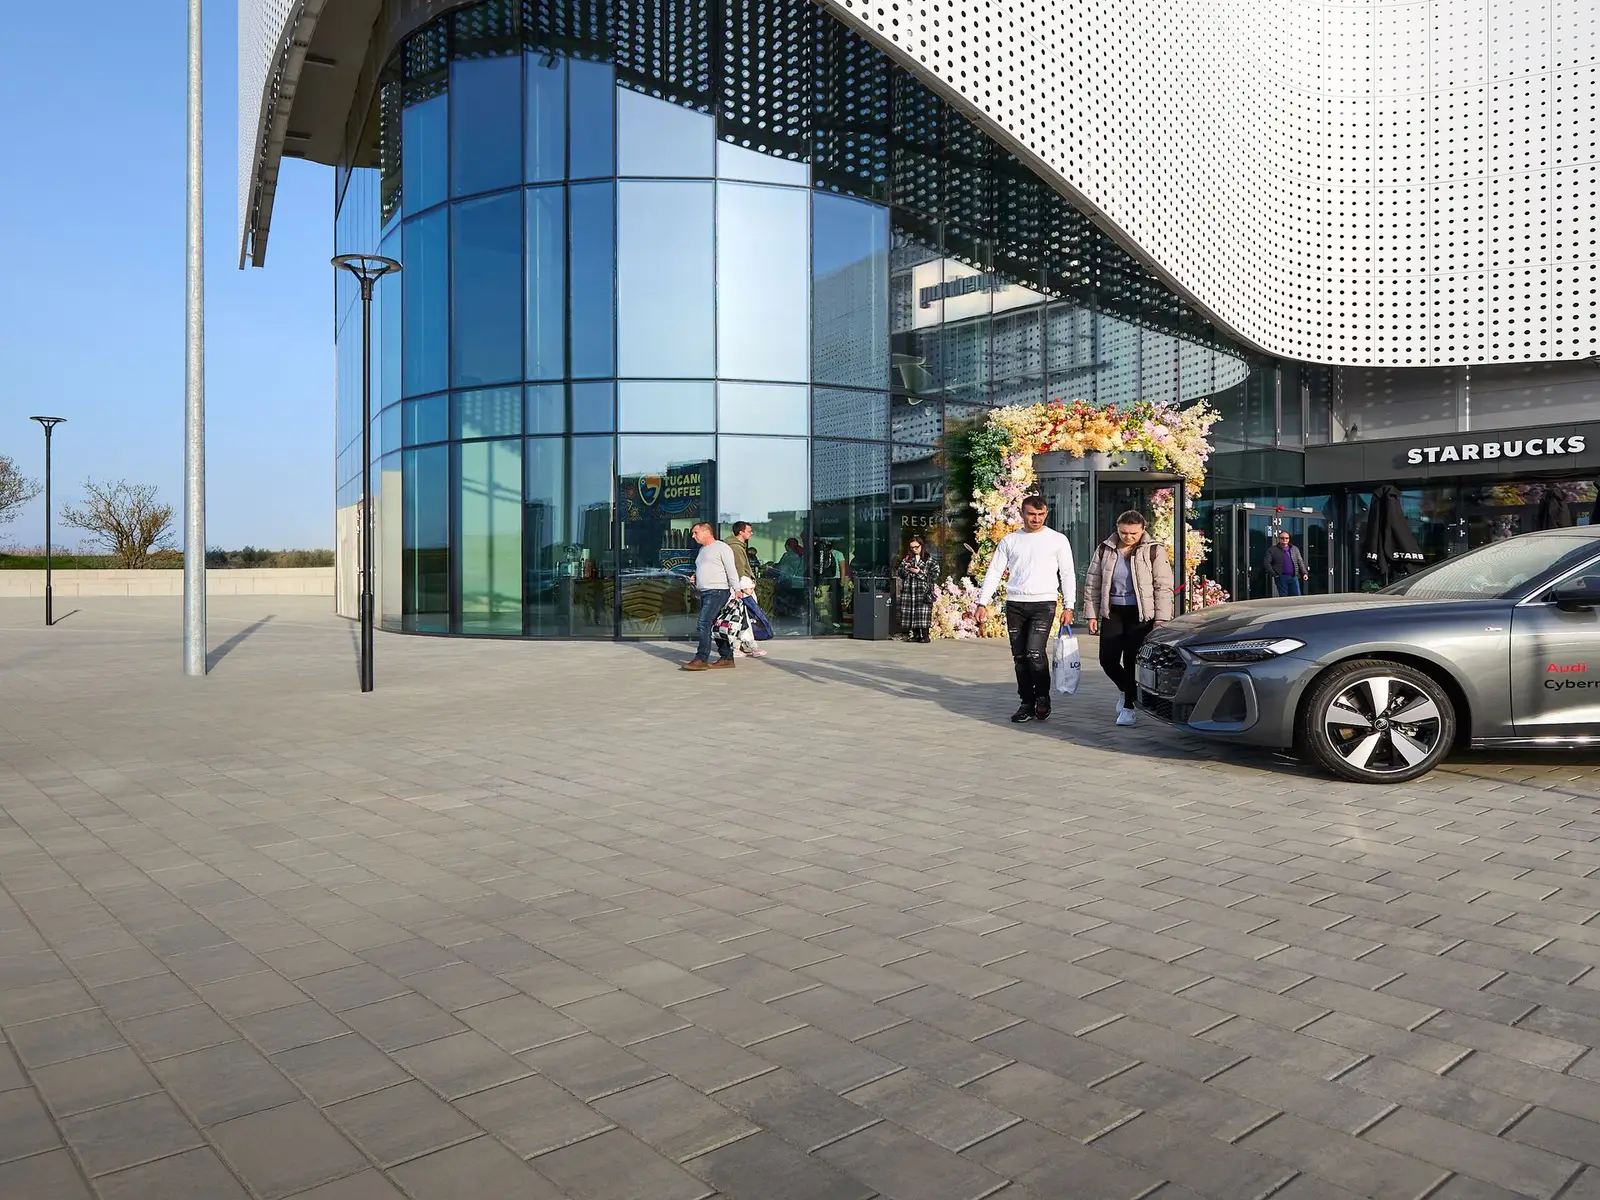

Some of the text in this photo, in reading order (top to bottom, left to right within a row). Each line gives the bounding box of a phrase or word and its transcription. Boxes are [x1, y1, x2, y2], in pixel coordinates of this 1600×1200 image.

[1408, 436, 1585, 464] STARBUCKS
[664, 486, 700, 498] COFFEE
[901, 515, 954, 527] RESEV
[1393, 552, 1424, 560] STARB
[1546, 662, 1588, 673] Audi
